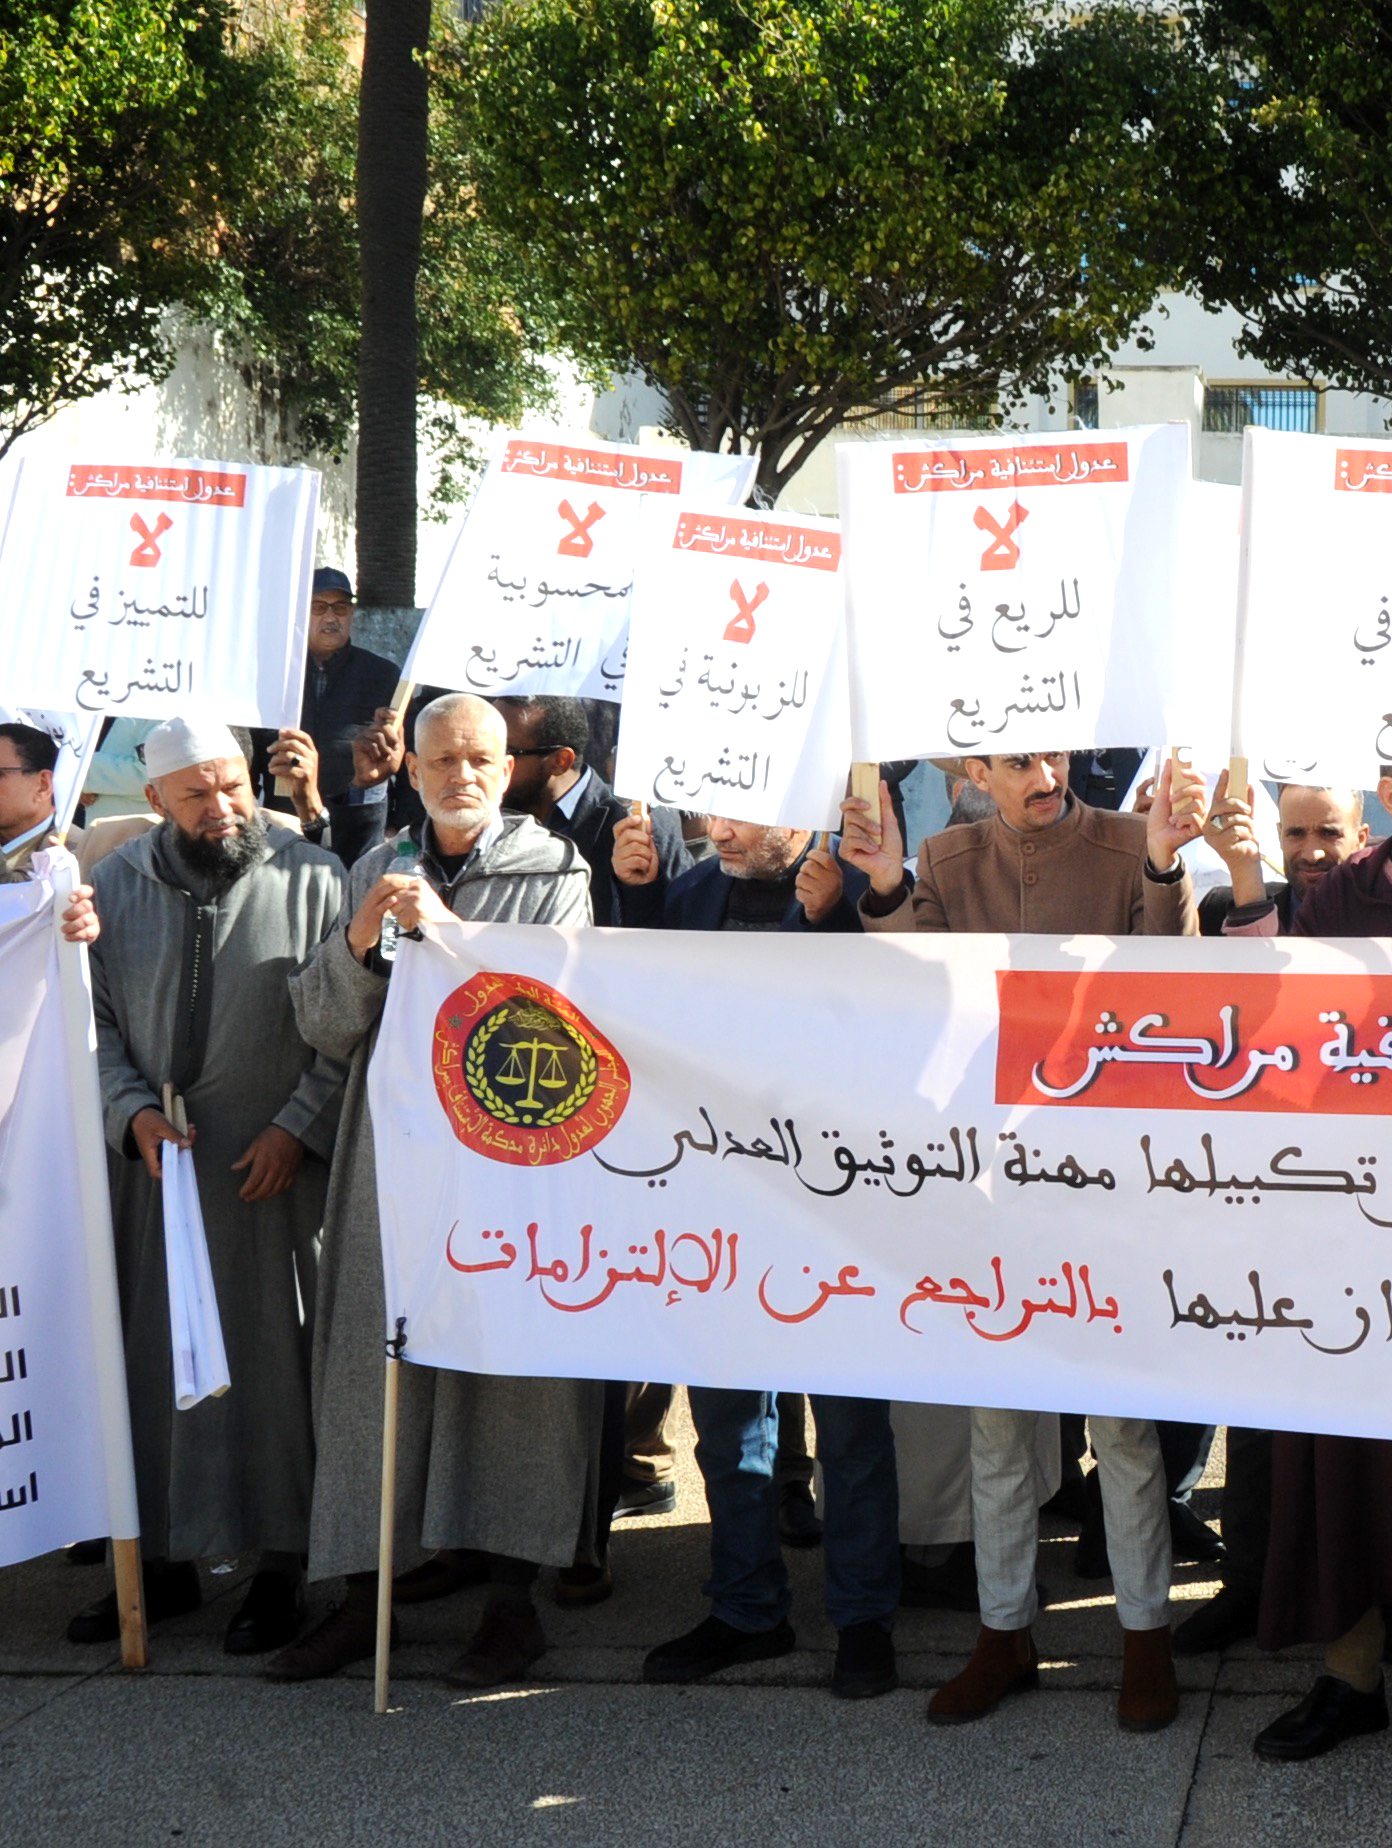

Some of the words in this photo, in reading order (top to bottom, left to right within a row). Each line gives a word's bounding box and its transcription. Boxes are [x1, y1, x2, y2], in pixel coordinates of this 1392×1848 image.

[183, 477, 236, 500] عدول
[618, 463, 672, 488] عدول
[1054, 453, 1116, 482] عدول
[130, 512, 173, 567] لا
[558, 500, 606, 558] لا
[782, 535, 832, 562] عدول
[974, 502, 1029, 571] لا
[71, 576, 99, 630] في
[110, 587, 207, 626] للتمييز
[488, 556, 631, 607] محسوبية
[723, 579, 769, 644] لا
[939, 584, 973, 652] في
[992, 579, 1079, 653] للريع
[1354, 597, 1391, 665] في
[76, 659, 192, 711] التشريع
[467, 638, 580, 687] التشريع
[659, 648, 687, 709] في
[699, 655, 807, 720] للزبونية
[948, 672, 1080, 748] التشريع
[654, 748, 769, 803] التشريع
[1033, 1006, 1293, 1099] مراكش
[481, 1121, 524, 1155] محكمة
[528, 1131, 560, 1165] دائرة
[590, 1106, 801, 1188] العدلي
[792, 1118, 980, 1197] التوثيق
[999, 1132, 1116, 1190] مهنة
[1140, 1133, 1377, 1204] تكبيلها
[446, 1219, 739, 1313] الإلتزامات
[759, 1266, 875, 1322] عن
[901, 1256, 1123, 1342] بالتراجع
[1163, 1269, 1313, 1341] عليها
